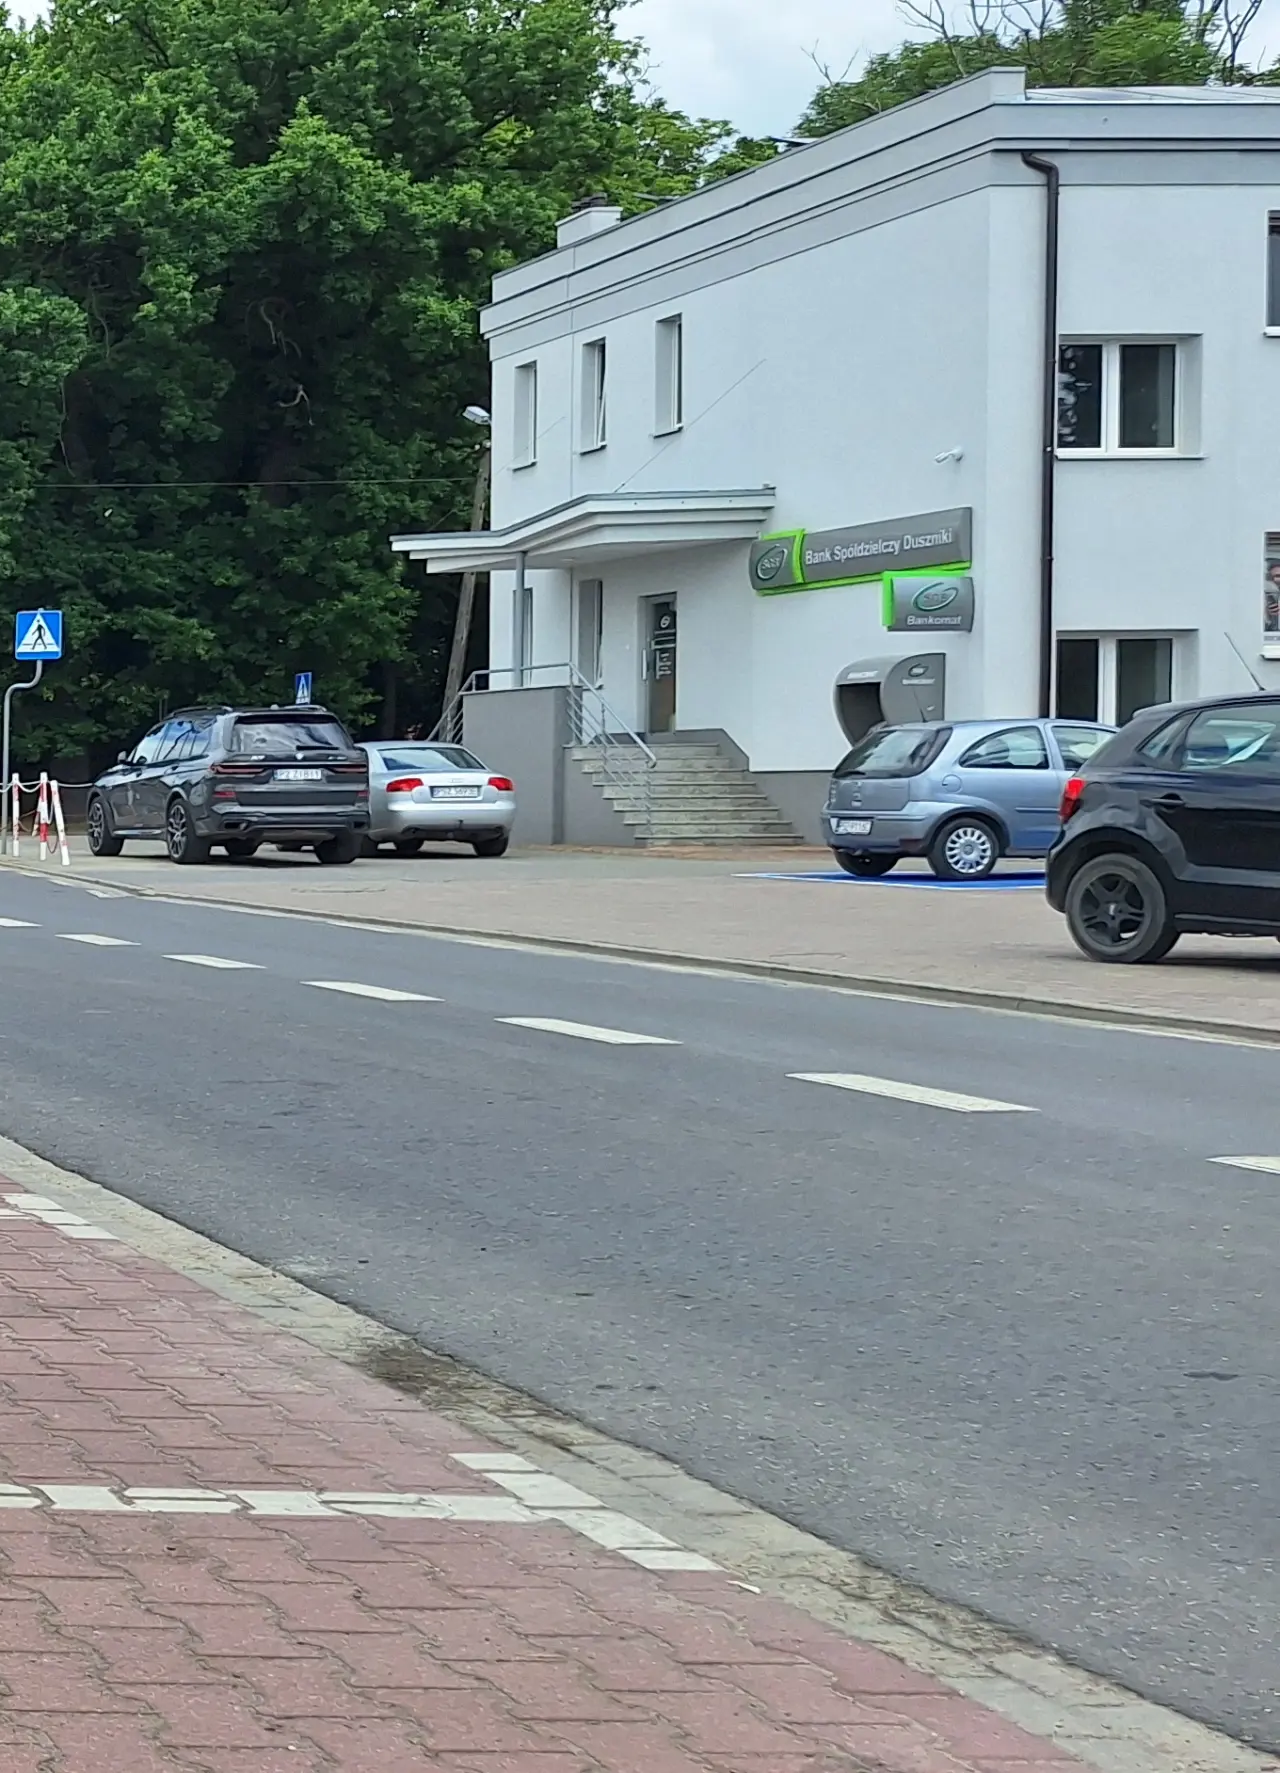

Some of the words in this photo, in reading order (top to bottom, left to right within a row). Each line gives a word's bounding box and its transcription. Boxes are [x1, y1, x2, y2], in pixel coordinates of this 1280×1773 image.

[805, 550, 832, 565] Bank
[903, 528, 953, 550] Duszniki
[906, 615, 963, 626] Bankomat
